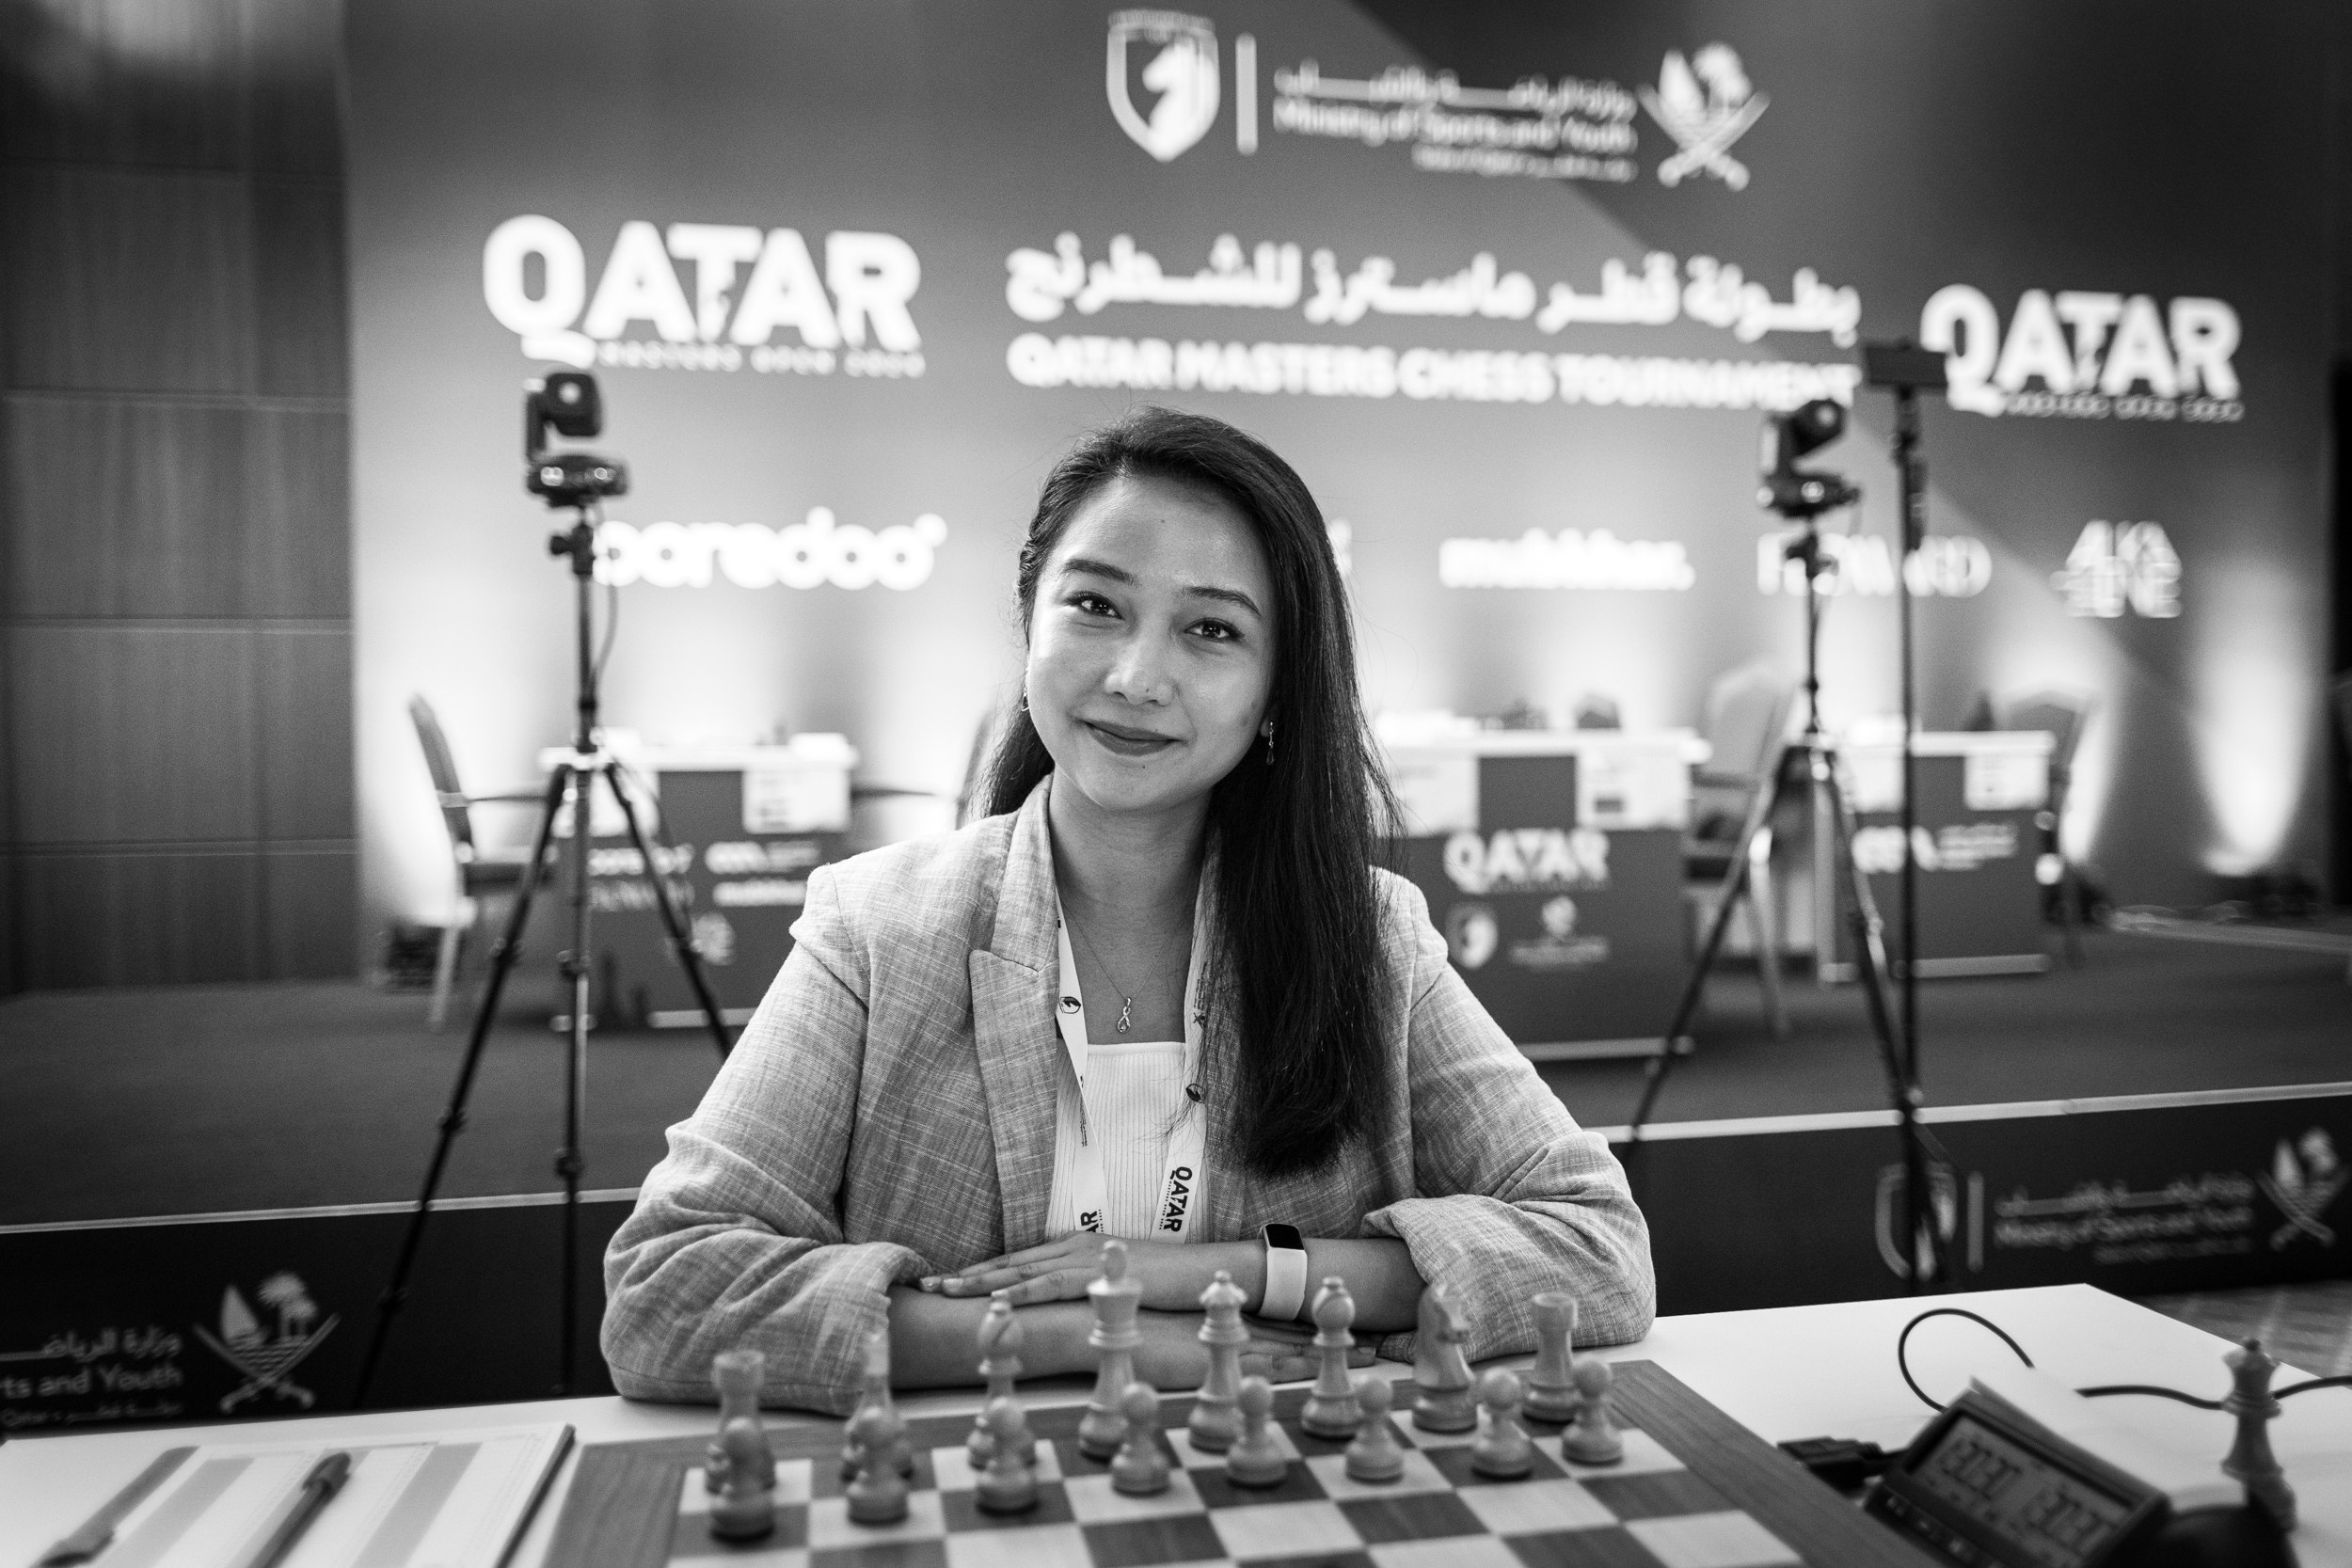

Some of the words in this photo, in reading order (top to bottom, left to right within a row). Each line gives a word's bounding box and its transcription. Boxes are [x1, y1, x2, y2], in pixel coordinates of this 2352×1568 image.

[483, 214, 922, 370] QATAR
[1007, 333, 1173, 388] QATAR
[1175, 341, 1397, 397] MASTERS
[1398, 346, 1555, 403] CHESS
[1919, 283, 2241, 417] QATAR
[1163, 1165, 1193, 1232] QATAR
[38, 1365, 91, 1398] and
[97, 1361, 184, 1392] Youth
